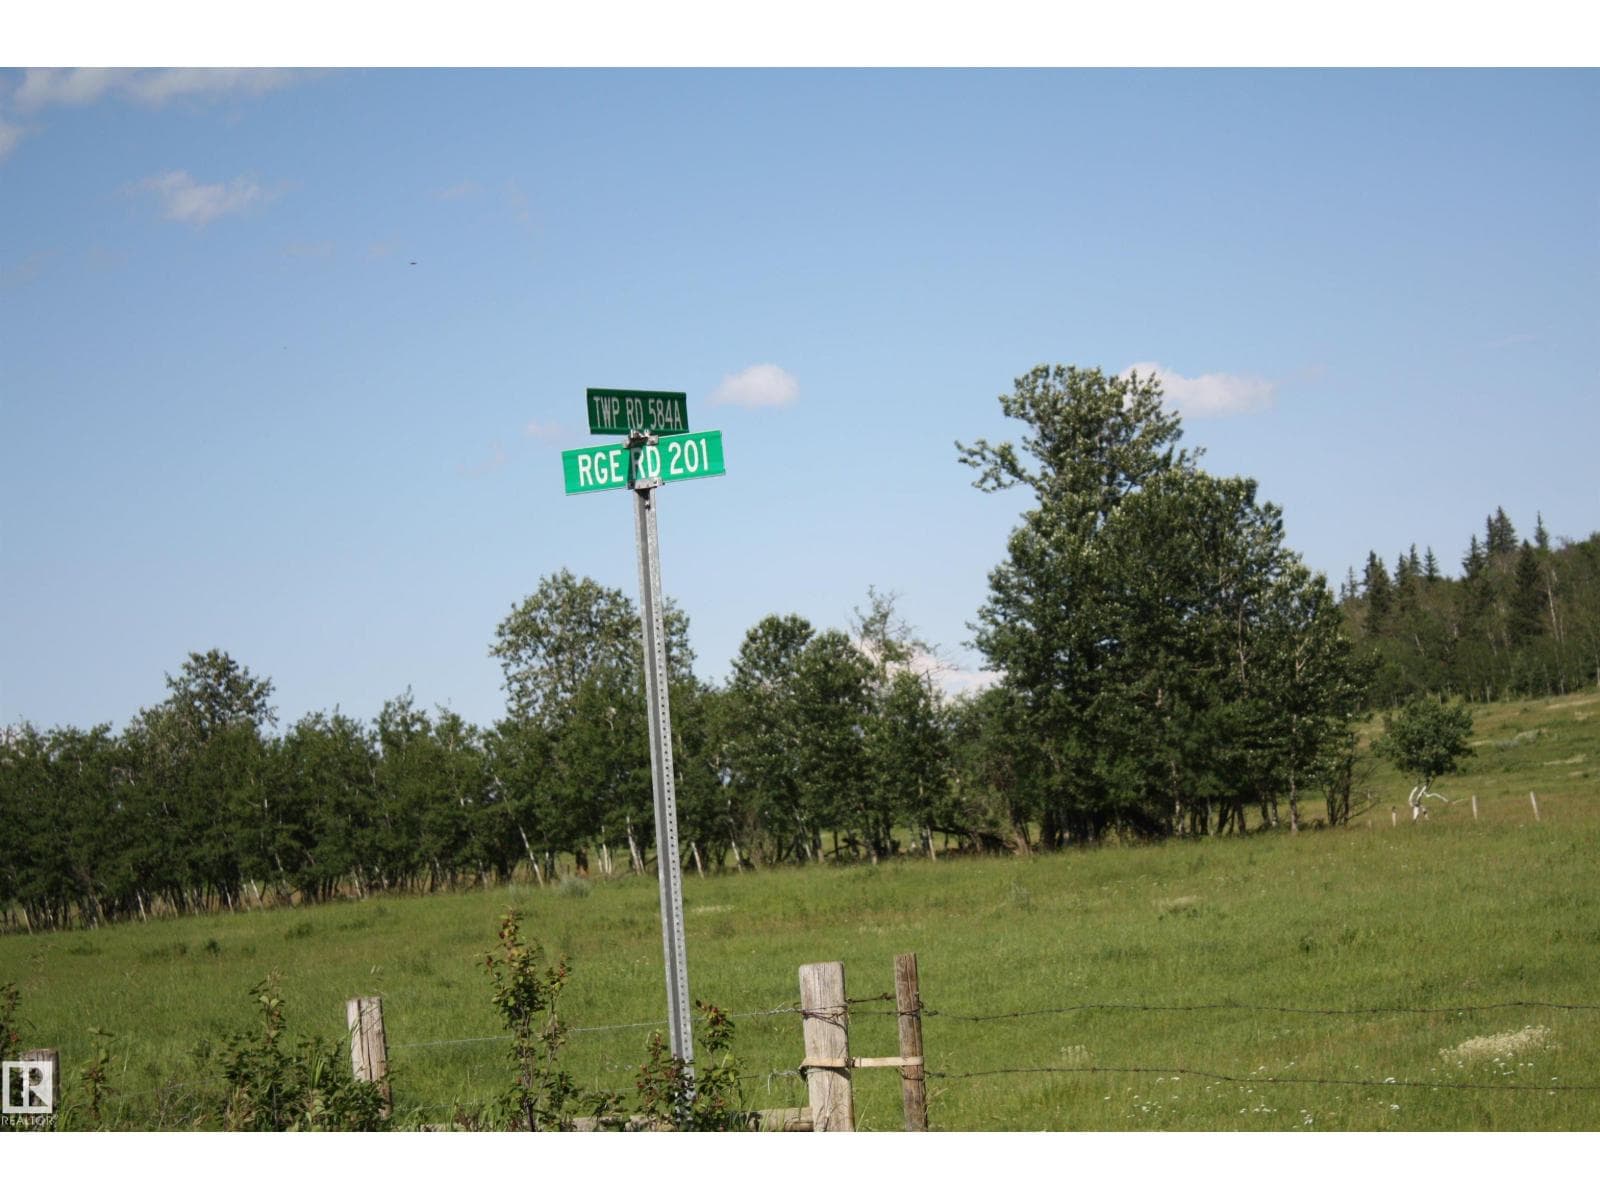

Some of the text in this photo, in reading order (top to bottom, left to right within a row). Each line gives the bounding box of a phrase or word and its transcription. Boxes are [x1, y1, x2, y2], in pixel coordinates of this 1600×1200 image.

[593, 396, 683, 431] TWP RD 584A
[577, 438, 709, 487] RGE RD 201
